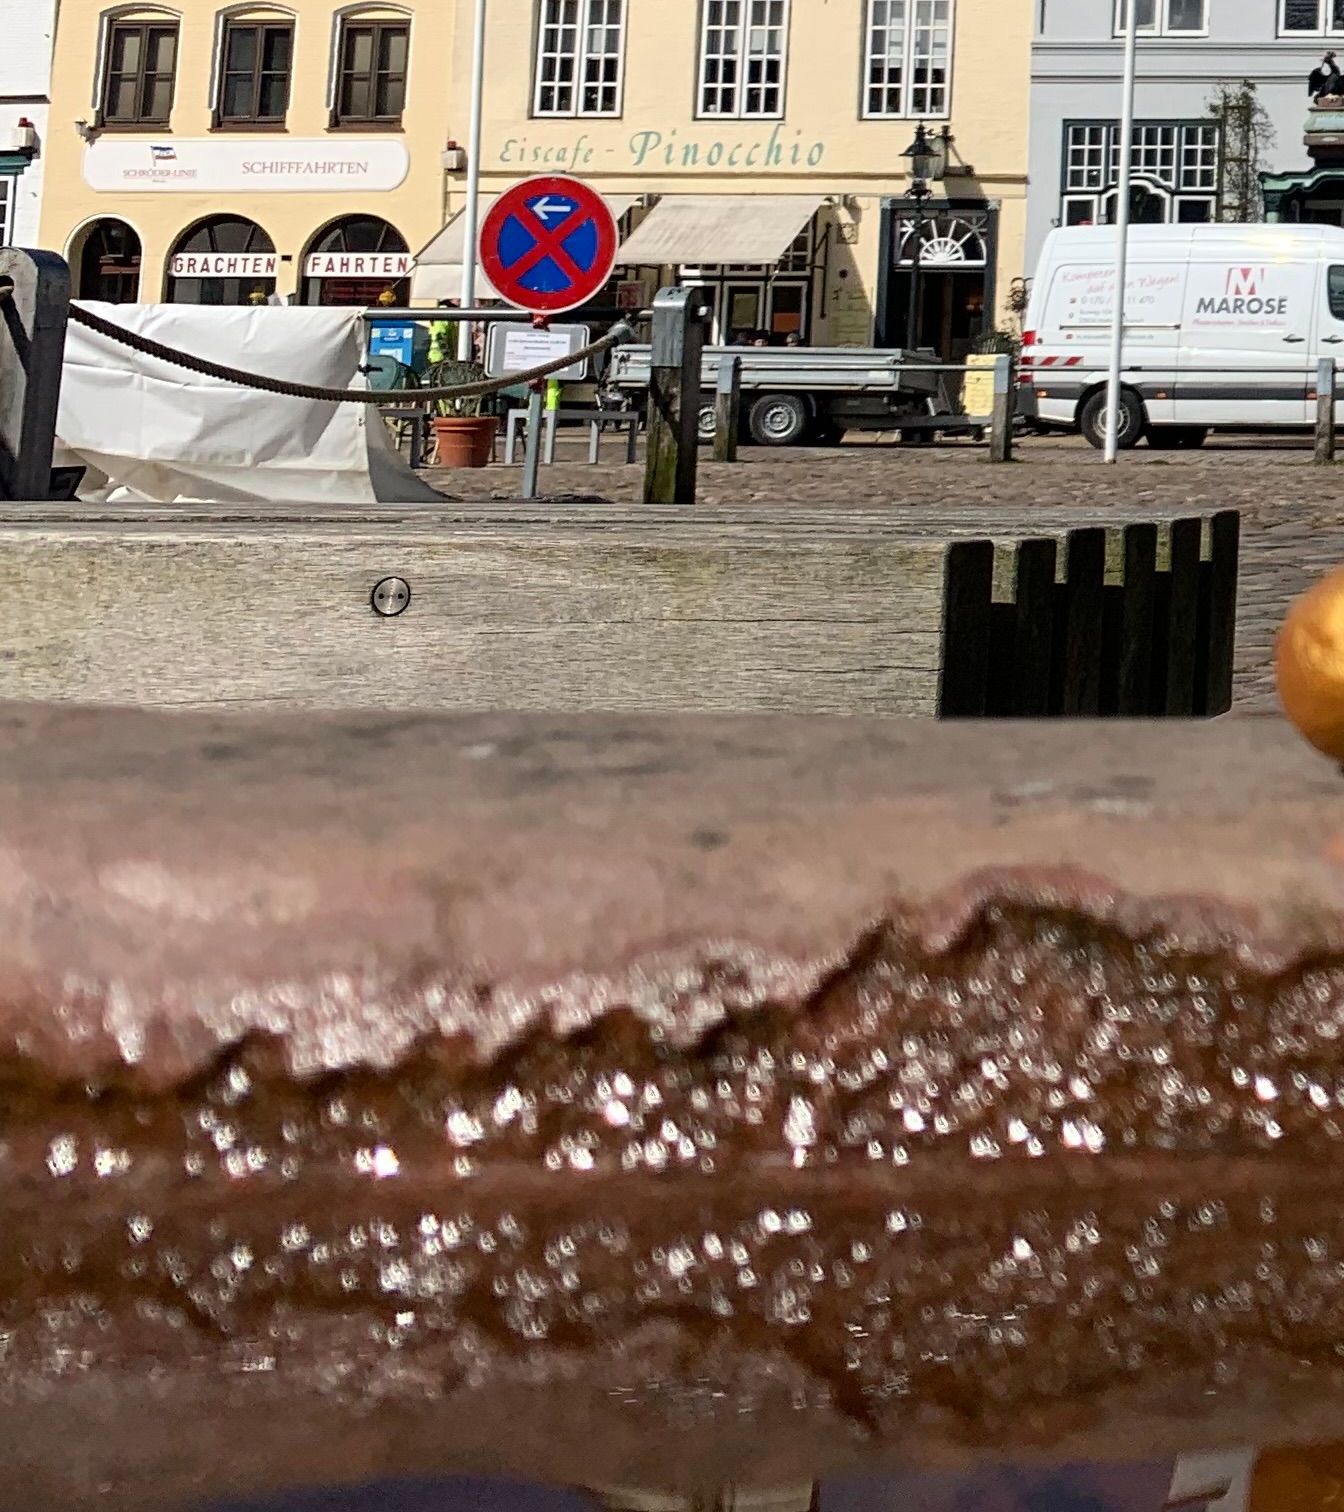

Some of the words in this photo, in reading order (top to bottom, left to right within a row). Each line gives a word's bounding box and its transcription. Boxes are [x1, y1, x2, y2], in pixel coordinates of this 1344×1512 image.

[499, 134, 594, 170] Eiscafe
[629, 123, 825, 167] Pinocchio
[242, 161, 369, 174] SCHIFFFAHRTEN
[173, 257, 276, 274] GRACHTEN
[311, 256, 408, 273] FAHRTEN
[1195, 297, 1288, 314] MAROSE
